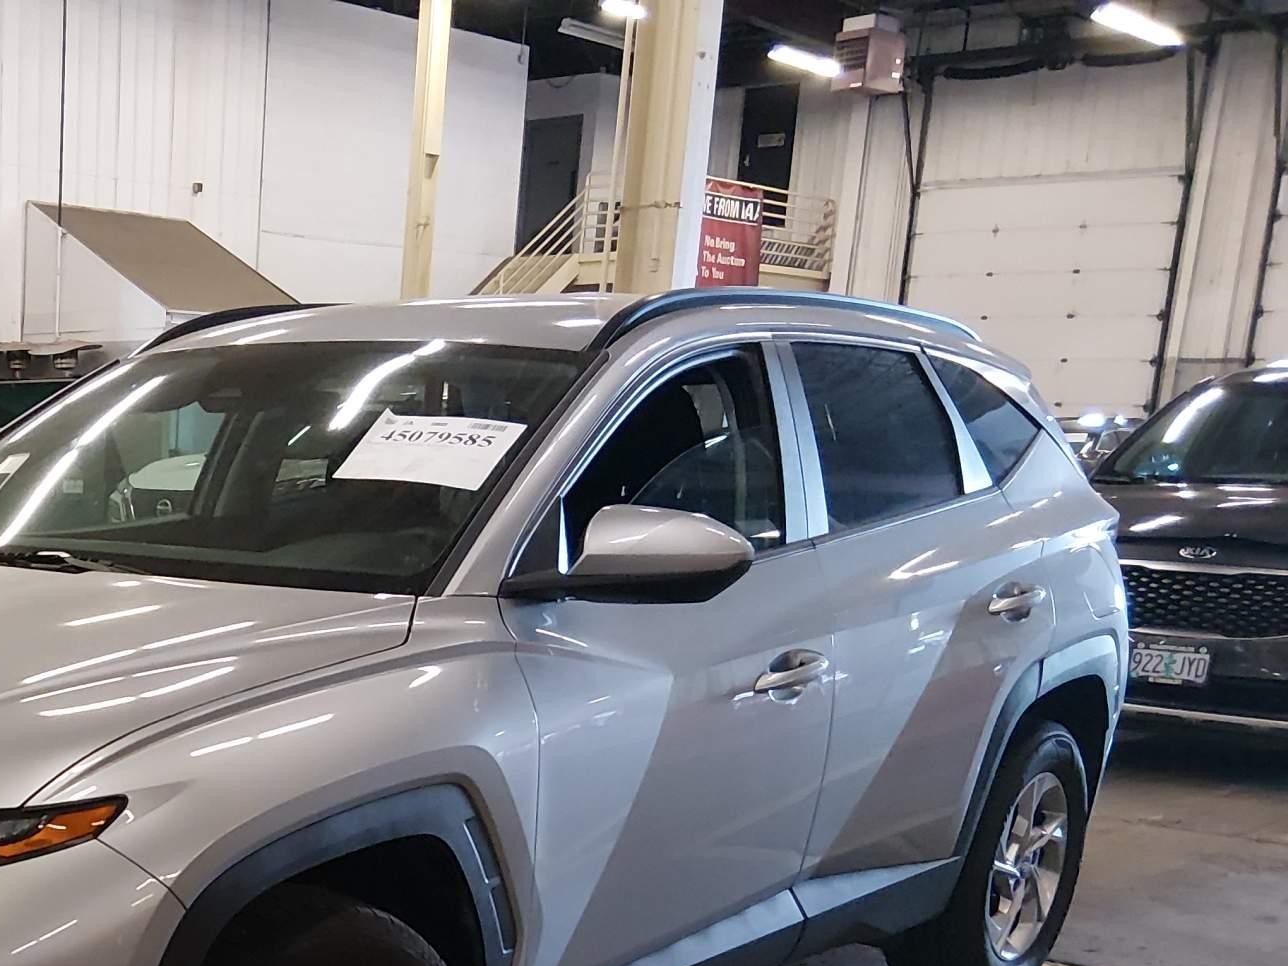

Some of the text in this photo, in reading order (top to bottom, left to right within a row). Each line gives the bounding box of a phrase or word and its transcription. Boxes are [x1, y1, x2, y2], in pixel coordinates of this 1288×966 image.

[714, 196, 740, 220] FROM
[715, 237, 735, 251] Bring
[703, 250, 746, 267] The Auction
[701, 266, 724, 280] To You
[380, 430, 497, 449] 45079585
[1183, 546, 1211, 556] KIA
[1131, 652, 1207, 679] 922 JYD
